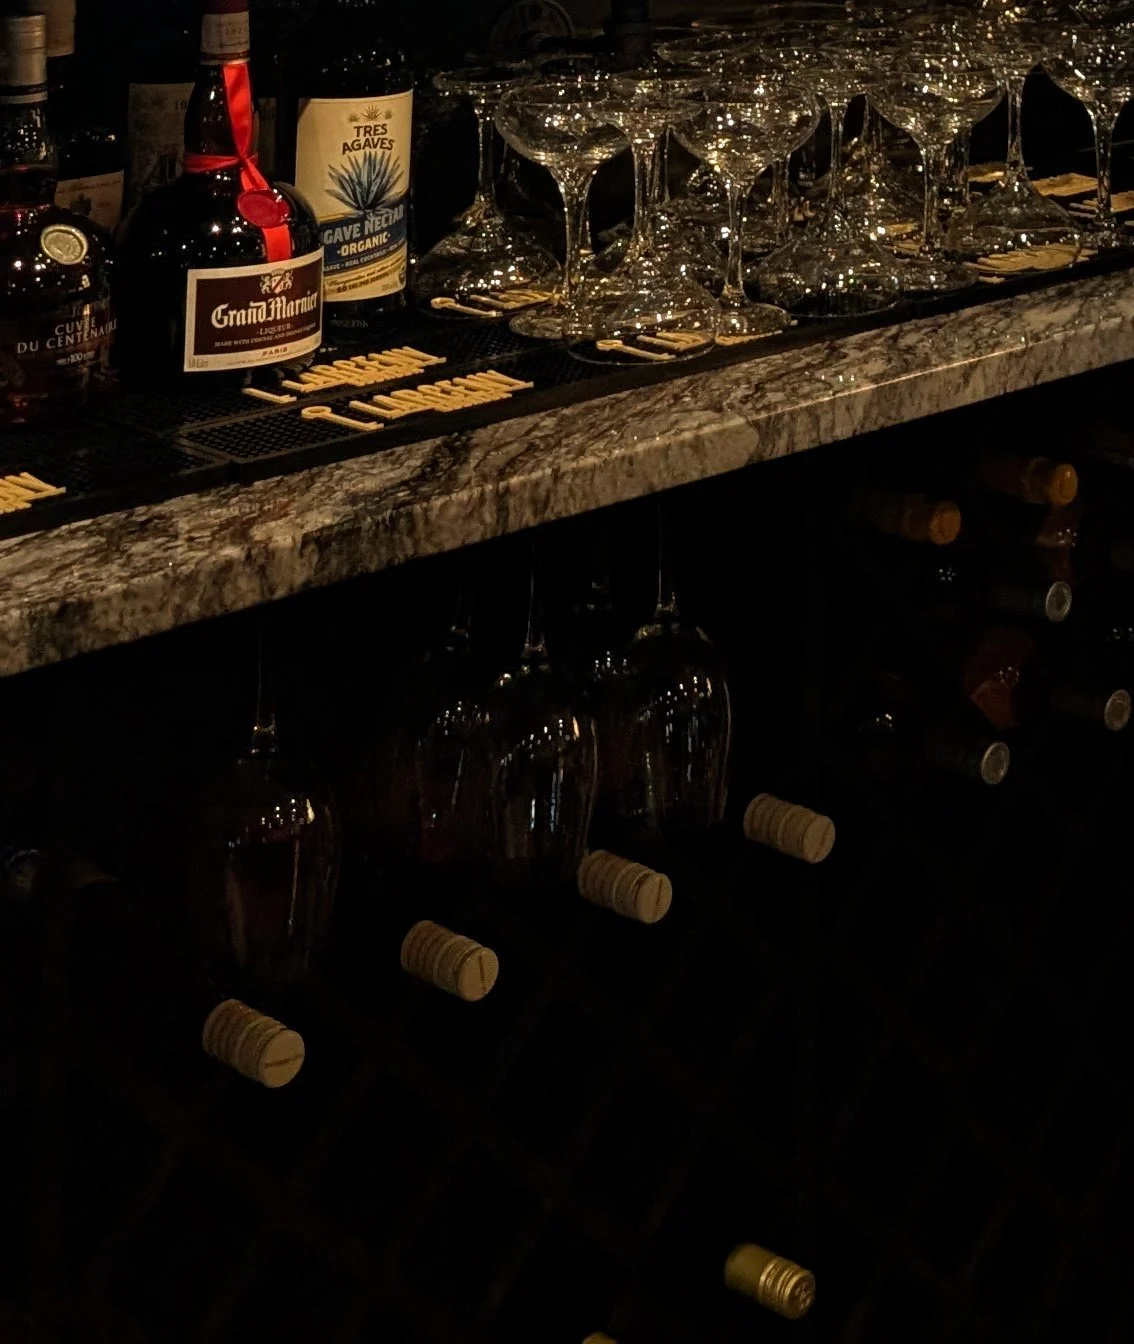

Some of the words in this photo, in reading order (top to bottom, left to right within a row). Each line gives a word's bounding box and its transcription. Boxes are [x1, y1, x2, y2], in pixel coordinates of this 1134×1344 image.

[353, 123, 388, 138] TRES
[341, 137, 395, 155] AGAVES
[323, 222, 361, 245] GAVE
[340, 231, 389, 257] ORGANIC
[211, 301, 267, 329] Grand
[265, 290, 318, 322] Marnier
[55, 316, 97, 336] CUVE
[17, 339, 39, 354] DU
[262, 346, 288, 357] PARIS
